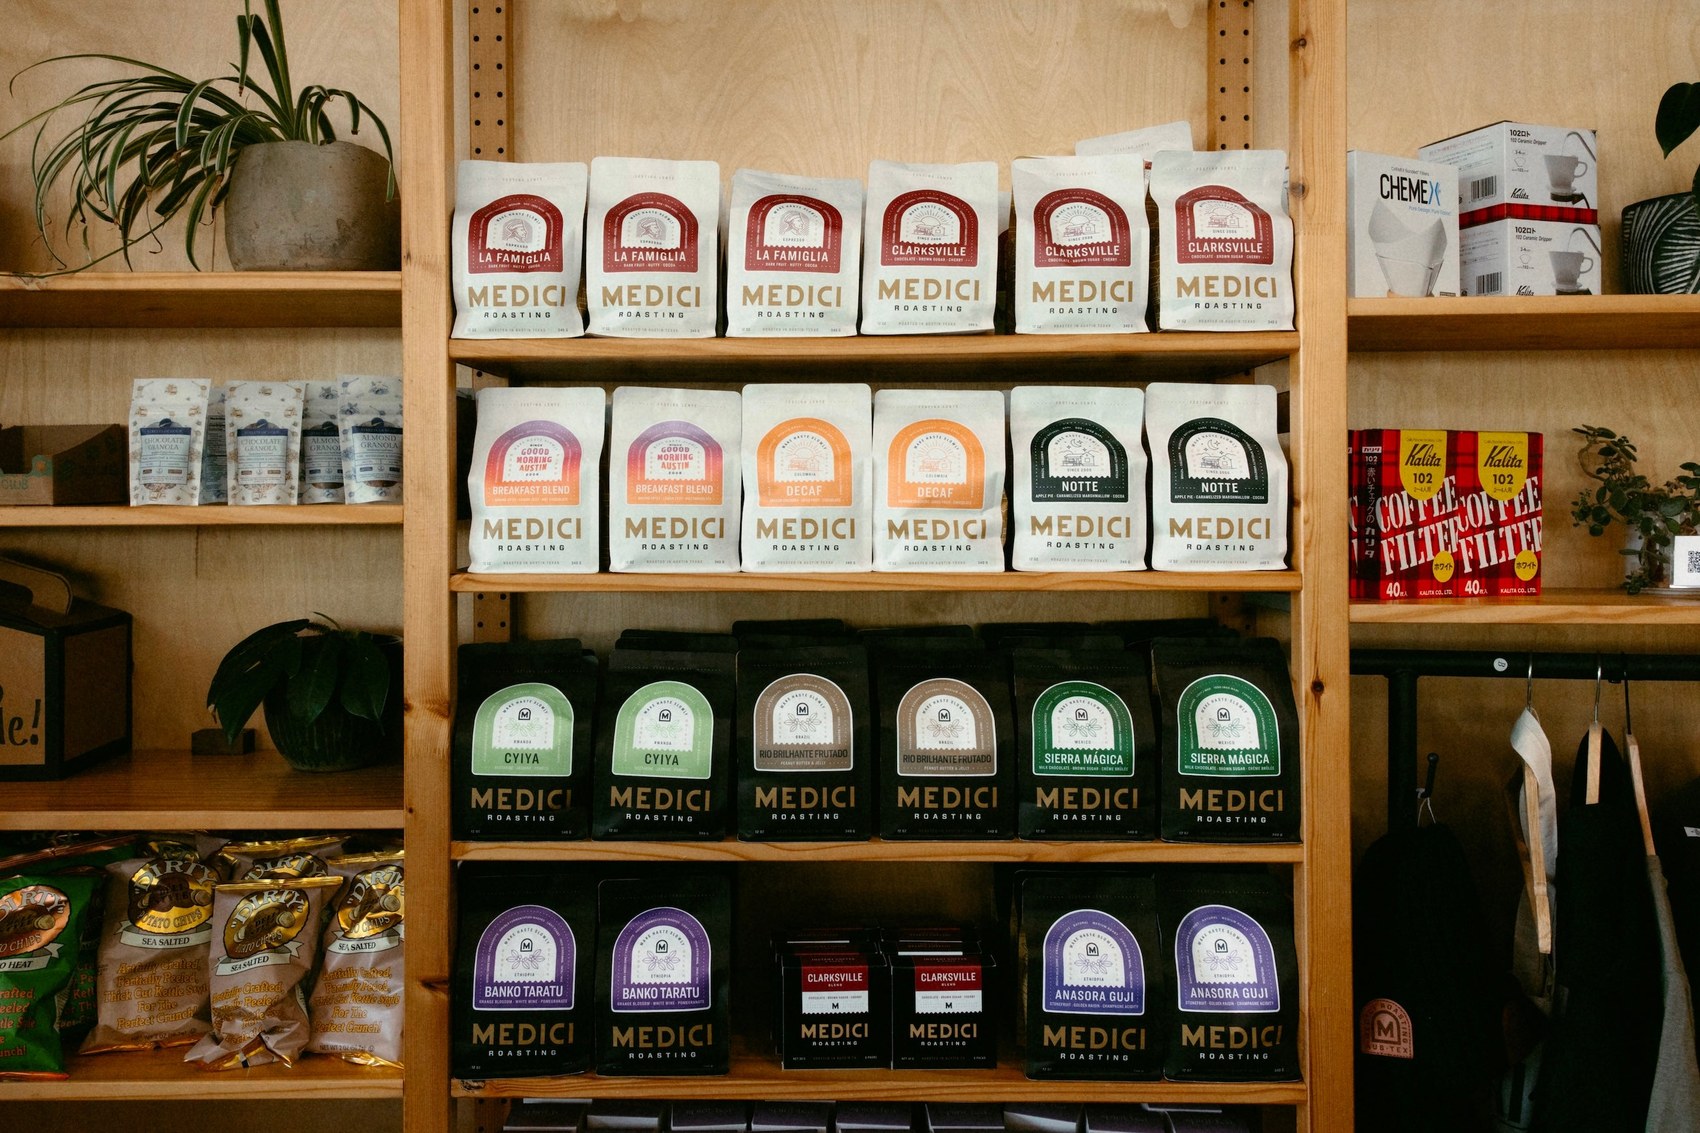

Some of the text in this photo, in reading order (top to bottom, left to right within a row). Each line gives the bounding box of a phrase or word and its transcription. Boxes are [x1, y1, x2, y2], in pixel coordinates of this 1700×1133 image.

[1380, 174, 1440, 206] CHEMEX
[1511, 188, 1529, 199] Kalita
[892, 245, 966, 257] CLARKSVILLE
[1045, 245, 1120, 258] CLARKSVILLE
[1188, 242, 1263, 254] CLARKSVILLE
[479, 252, 551, 265] LA FAMIGLIA
[614, 251, 686, 262] LA FAMIGLIA
[756, 250, 828, 262] LA FAMIGLIA
[879, 279, 979, 301] MEDICI
[1032, 281, 1133, 302] MEDICI
[1176, 276, 1276, 298] MEDICI
[468, 285, 566, 308] MEDICI
[602, 285, 701, 308] MEDICI
[742, 285, 841, 307] MEDICI
[1195, 302, 1262, 310] ROASTING
[516, 456, 552, 464] MORNING
[1405, 444, 1441, 467] Kalita
[1484, 446, 1523, 468] Kalita
[519, 463, 547, 471] AUSTIN
[661, 461, 689, 469] AUSTIN
[1413, 473, 1432, 483] 102
[1493, 474, 1513, 484] 102
[493, 486, 570, 495] BREAKFAST BLEND
[636, 485, 713, 494] BREAKFAST BLEND
[786, 487, 822, 496] DECAF
[917, 487, 954, 498] DECAF
[1061, 481, 1098, 492] NOTTE
[1201, 482, 1238, 493] NOTTE
[483, 518, 581, 540] MEDICI
[625, 517, 724, 539] MEDICI
[757, 518, 855, 539] MEDICI
[888, 519, 986, 540] MEDICI
[1031, 516, 1131, 538] MEDICI
[1170, 518, 1270, 539] MEDICI
[904, 544, 972, 552] ROASTING
[1187, 543, 1254, 551] ROASTING
[504, 753, 539, 764] CYIYA
[644, 754, 679, 765] CYIYA
[759, 749, 847, 759] RIO BRILHANTE FRUTADO
[903, 754, 991, 764] RIO BRILHANTE FRUTADO
[1045, 751, 1123, 765] SIERRA MÁGICA
[1191, 750, 1269, 764] SIERRA MÁGICA
[471, 789, 572, 810] MEDICI
[611, 786, 710, 811] MEDICI
[755, 786, 854, 808] MEDICI
[898, 787, 997, 808] MEDICI
[1037, 787, 1137, 809] MEDICI
[1179, 789, 1282, 811] MEDICI
[487, 814, 555, 822] ROASTING
[626, 813, 693, 822] ROASTING
[174, 909, 202, 927] CHIPS
[10, 934, 42, 951] CHIPS
[159, 937, 189, 946] SALTED
[339, 942, 376, 951] SEA SALTED
[8, 961, 33, 969] HEAT
[230, 956, 269, 972] SEA SALTED
[807, 972, 862, 983] CLARKSVILLE
[921, 972, 975, 982] CLARKSVILLE
[485, 986, 563, 997] BANKO TARATU
[623, 987, 699, 999] BANKO TARATU
[1055, 990, 1134, 1001] ANASORA GUJI
[1191, 987, 1268, 998] ANASORA GUJI
[138, 1000, 177, 1012] For The
[117, 1016, 155, 1030] Perfect
[1377, 1020, 1394, 1037] M
[473, 1023, 574, 1045] MEDICI
[612, 1024, 712, 1047] MEDICI
[801, 1024, 868, 1038] MEDICI
[910, 1024, 977, 1038] MEDICI
[1043, 1025, 1145, 1049] MEDICI
[1182, 1024, 1282, 1048] MEDICI
[1060, 1053, 1128, 1061] ROASTING
[1200, 1052, 1268, 1060] ROASTING
